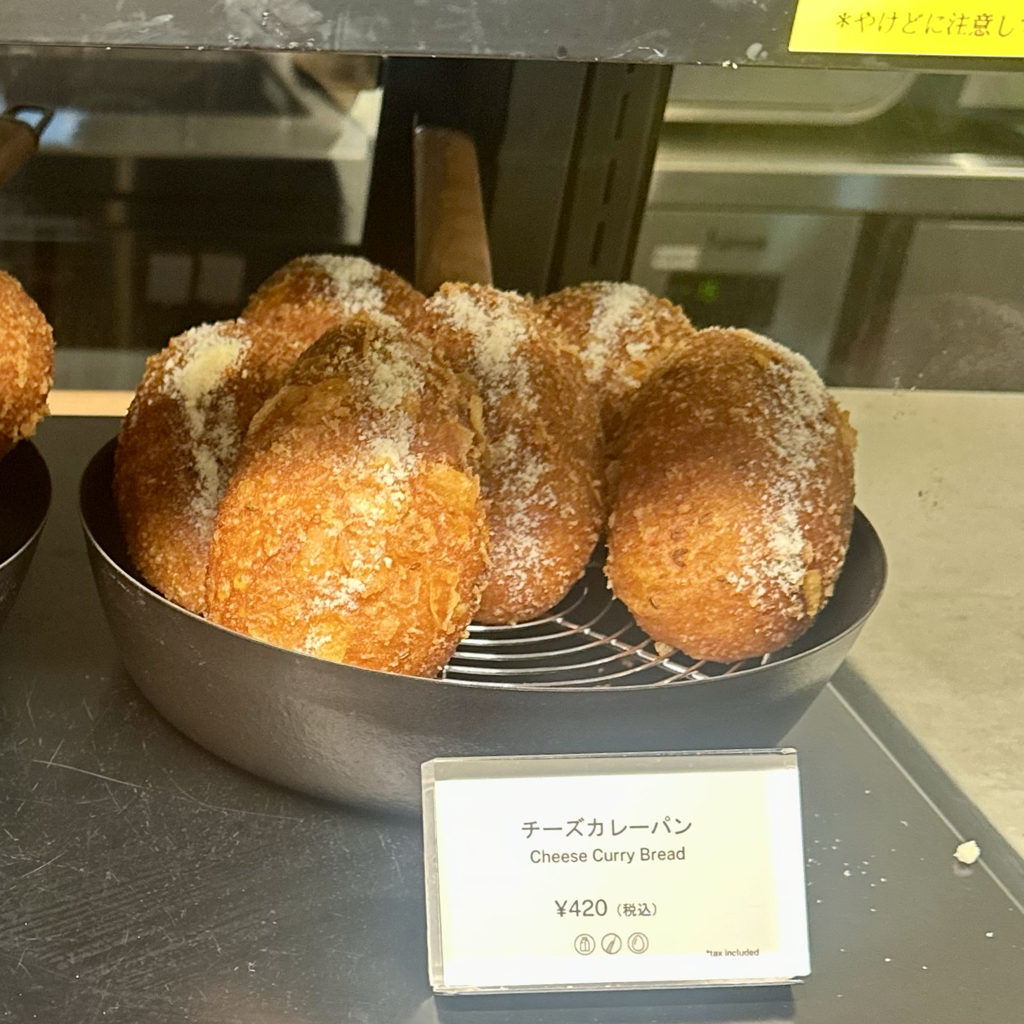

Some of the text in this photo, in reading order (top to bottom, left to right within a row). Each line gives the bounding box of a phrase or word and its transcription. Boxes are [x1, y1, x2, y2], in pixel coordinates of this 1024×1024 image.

[836, 12, 1024, 37] やけどに注意し
[521, 815, 692, 839] チーズカレーパン
[529, 846, 686, 864] Cheese Curry Bread
[554, 898, 658, 917] ¥420 (税込)
[724, 948, 759, 957] included
